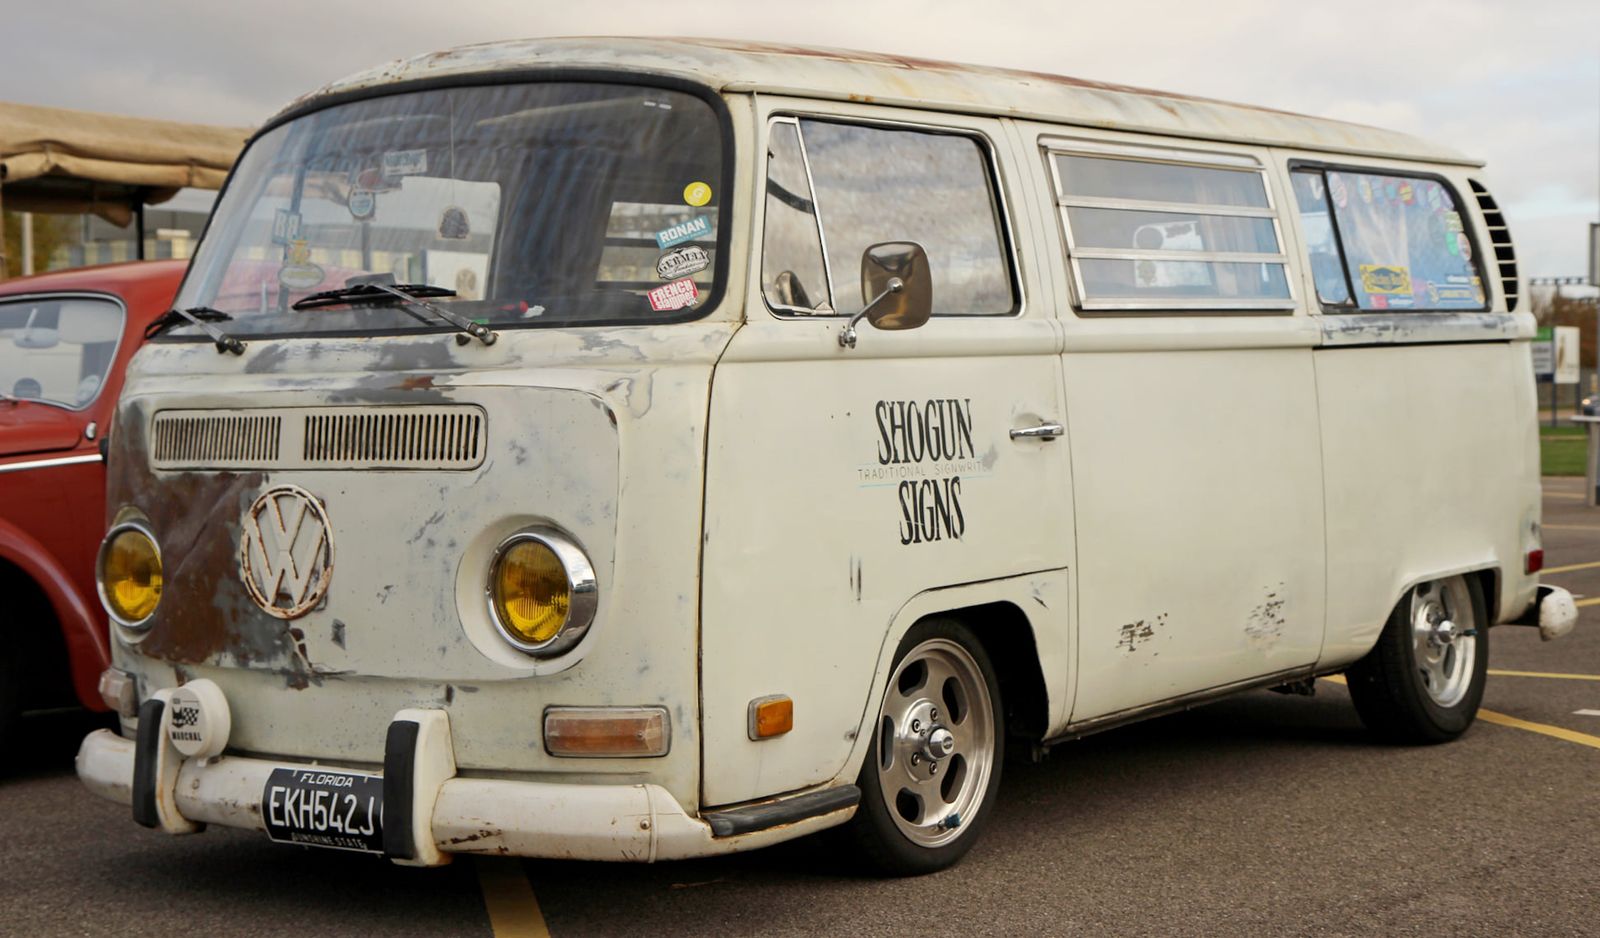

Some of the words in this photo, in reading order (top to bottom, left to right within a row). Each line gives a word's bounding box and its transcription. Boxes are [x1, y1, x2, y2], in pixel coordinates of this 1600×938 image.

[660, 218, 706, 243] RONAN
[651, 279, 694, 302] FRENCH
[875, 398, 975, 465] SHOGUN
[857, 466, 926, 481] TRADITIONAL
[898, 476, 965, 545] SIGNS
[300, 772, 354, 788] FLORIDA
[269, 785, 375, 836] EKH542J
